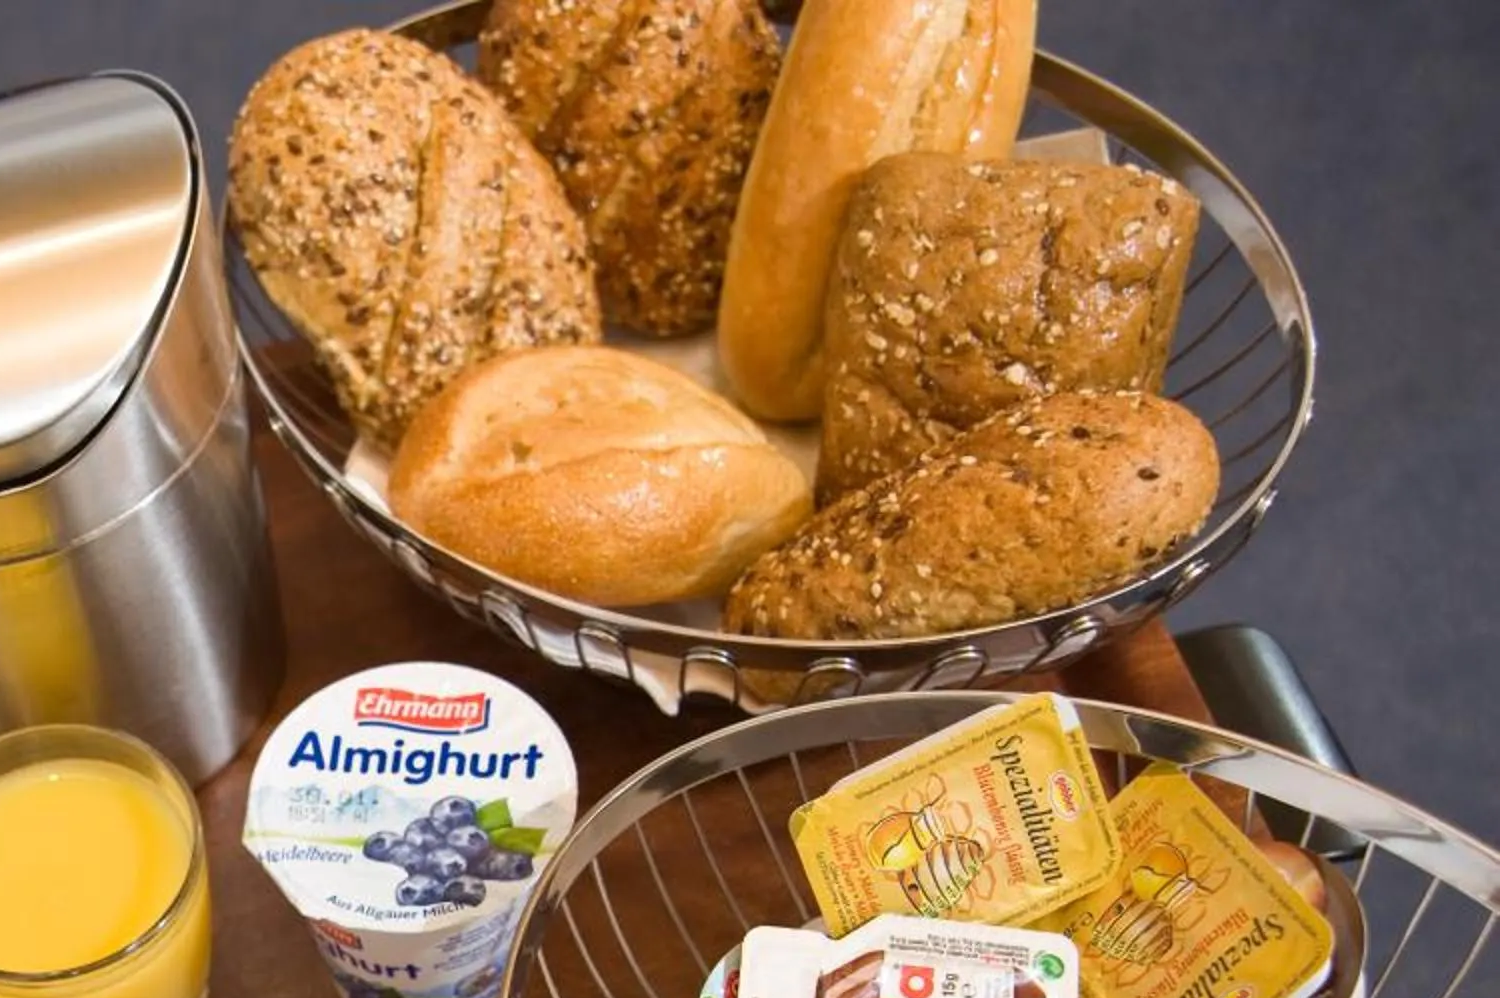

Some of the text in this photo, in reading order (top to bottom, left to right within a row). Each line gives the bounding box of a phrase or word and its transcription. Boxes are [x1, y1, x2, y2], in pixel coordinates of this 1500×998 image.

[358, 691, 479, 720] Ehrmann
[288, 730, 544, 785] Almighurt
[989, 733, 1065, 886] Spezialitäten
[422, 901, 465, 919] Milch
